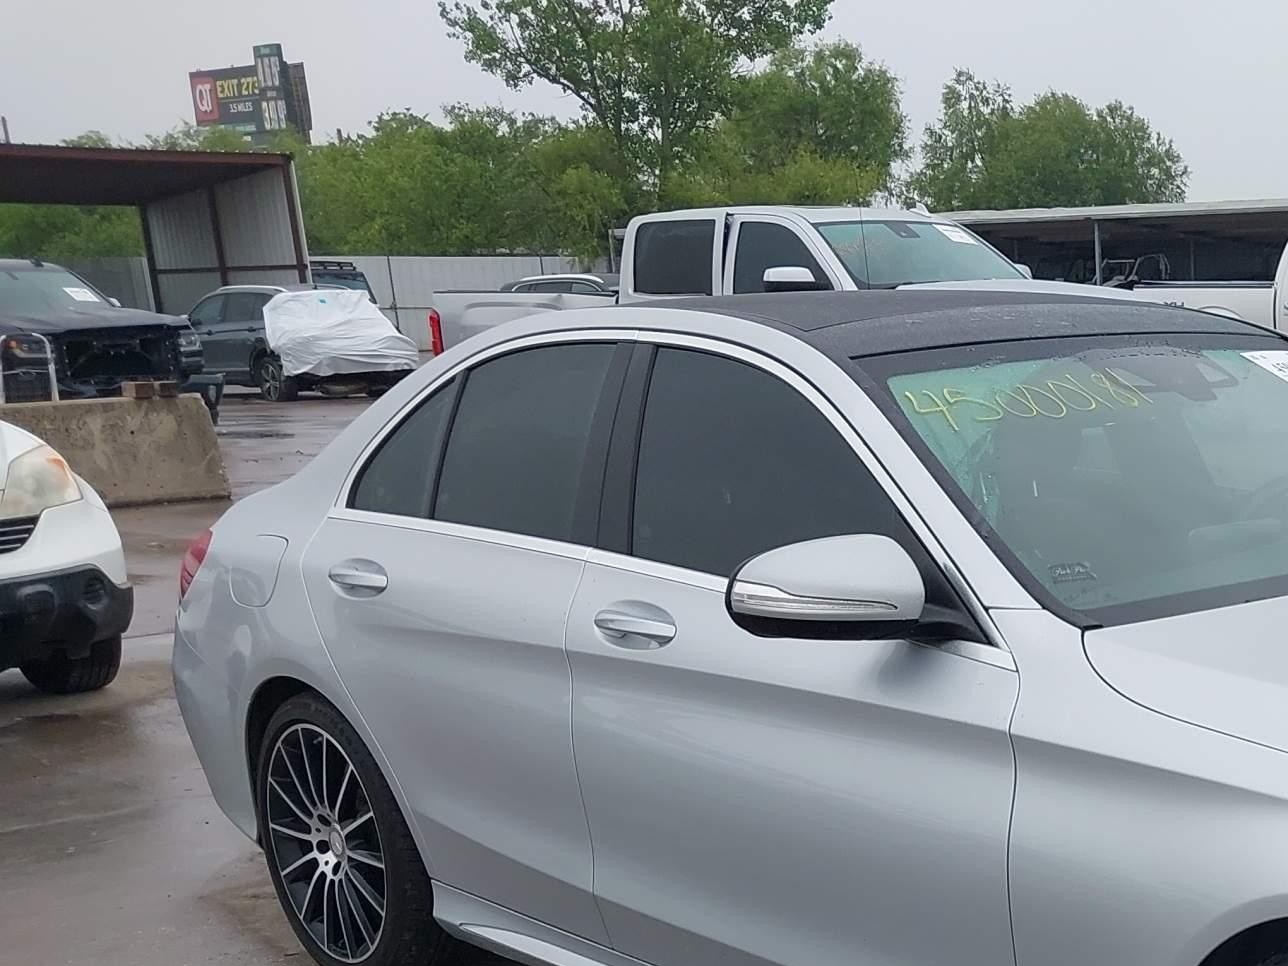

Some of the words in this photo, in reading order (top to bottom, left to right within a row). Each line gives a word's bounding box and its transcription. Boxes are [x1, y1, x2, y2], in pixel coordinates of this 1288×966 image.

[196, 83, 213, 113] QT
[216, 79, 238, 98] EXIT
[904, 367, 1153, 431] 45000181
